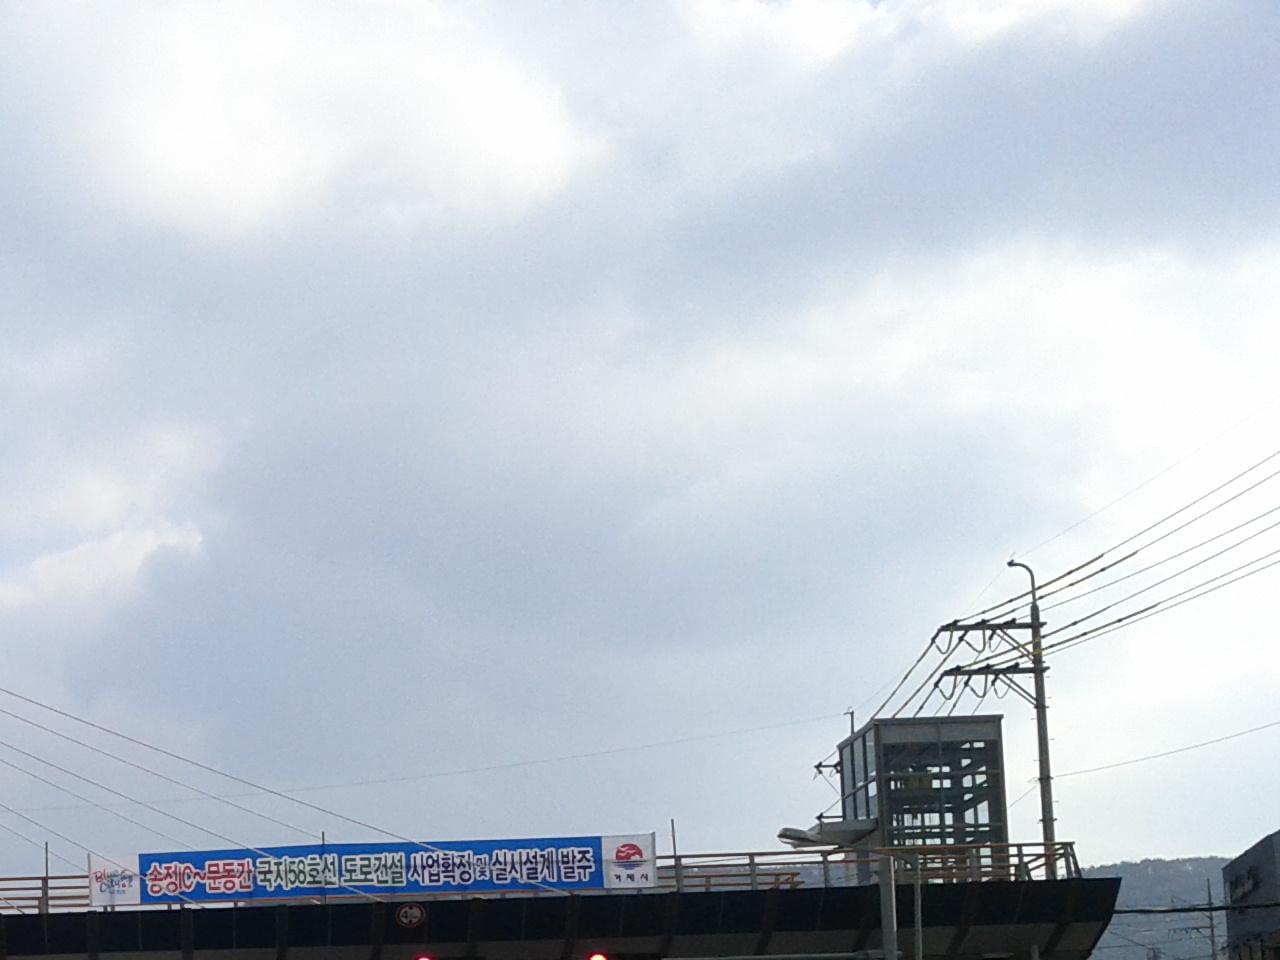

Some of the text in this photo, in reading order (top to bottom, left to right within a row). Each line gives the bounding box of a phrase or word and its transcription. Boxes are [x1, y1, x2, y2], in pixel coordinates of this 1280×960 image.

[341, 852, 406, 887] 도로건설
[409, 850, 473, 885] 사업확정
[475, 855, 489, 881] 및
[490, 848, 556, 882] 실시설계
[558, 847, 596, 881] 발주
